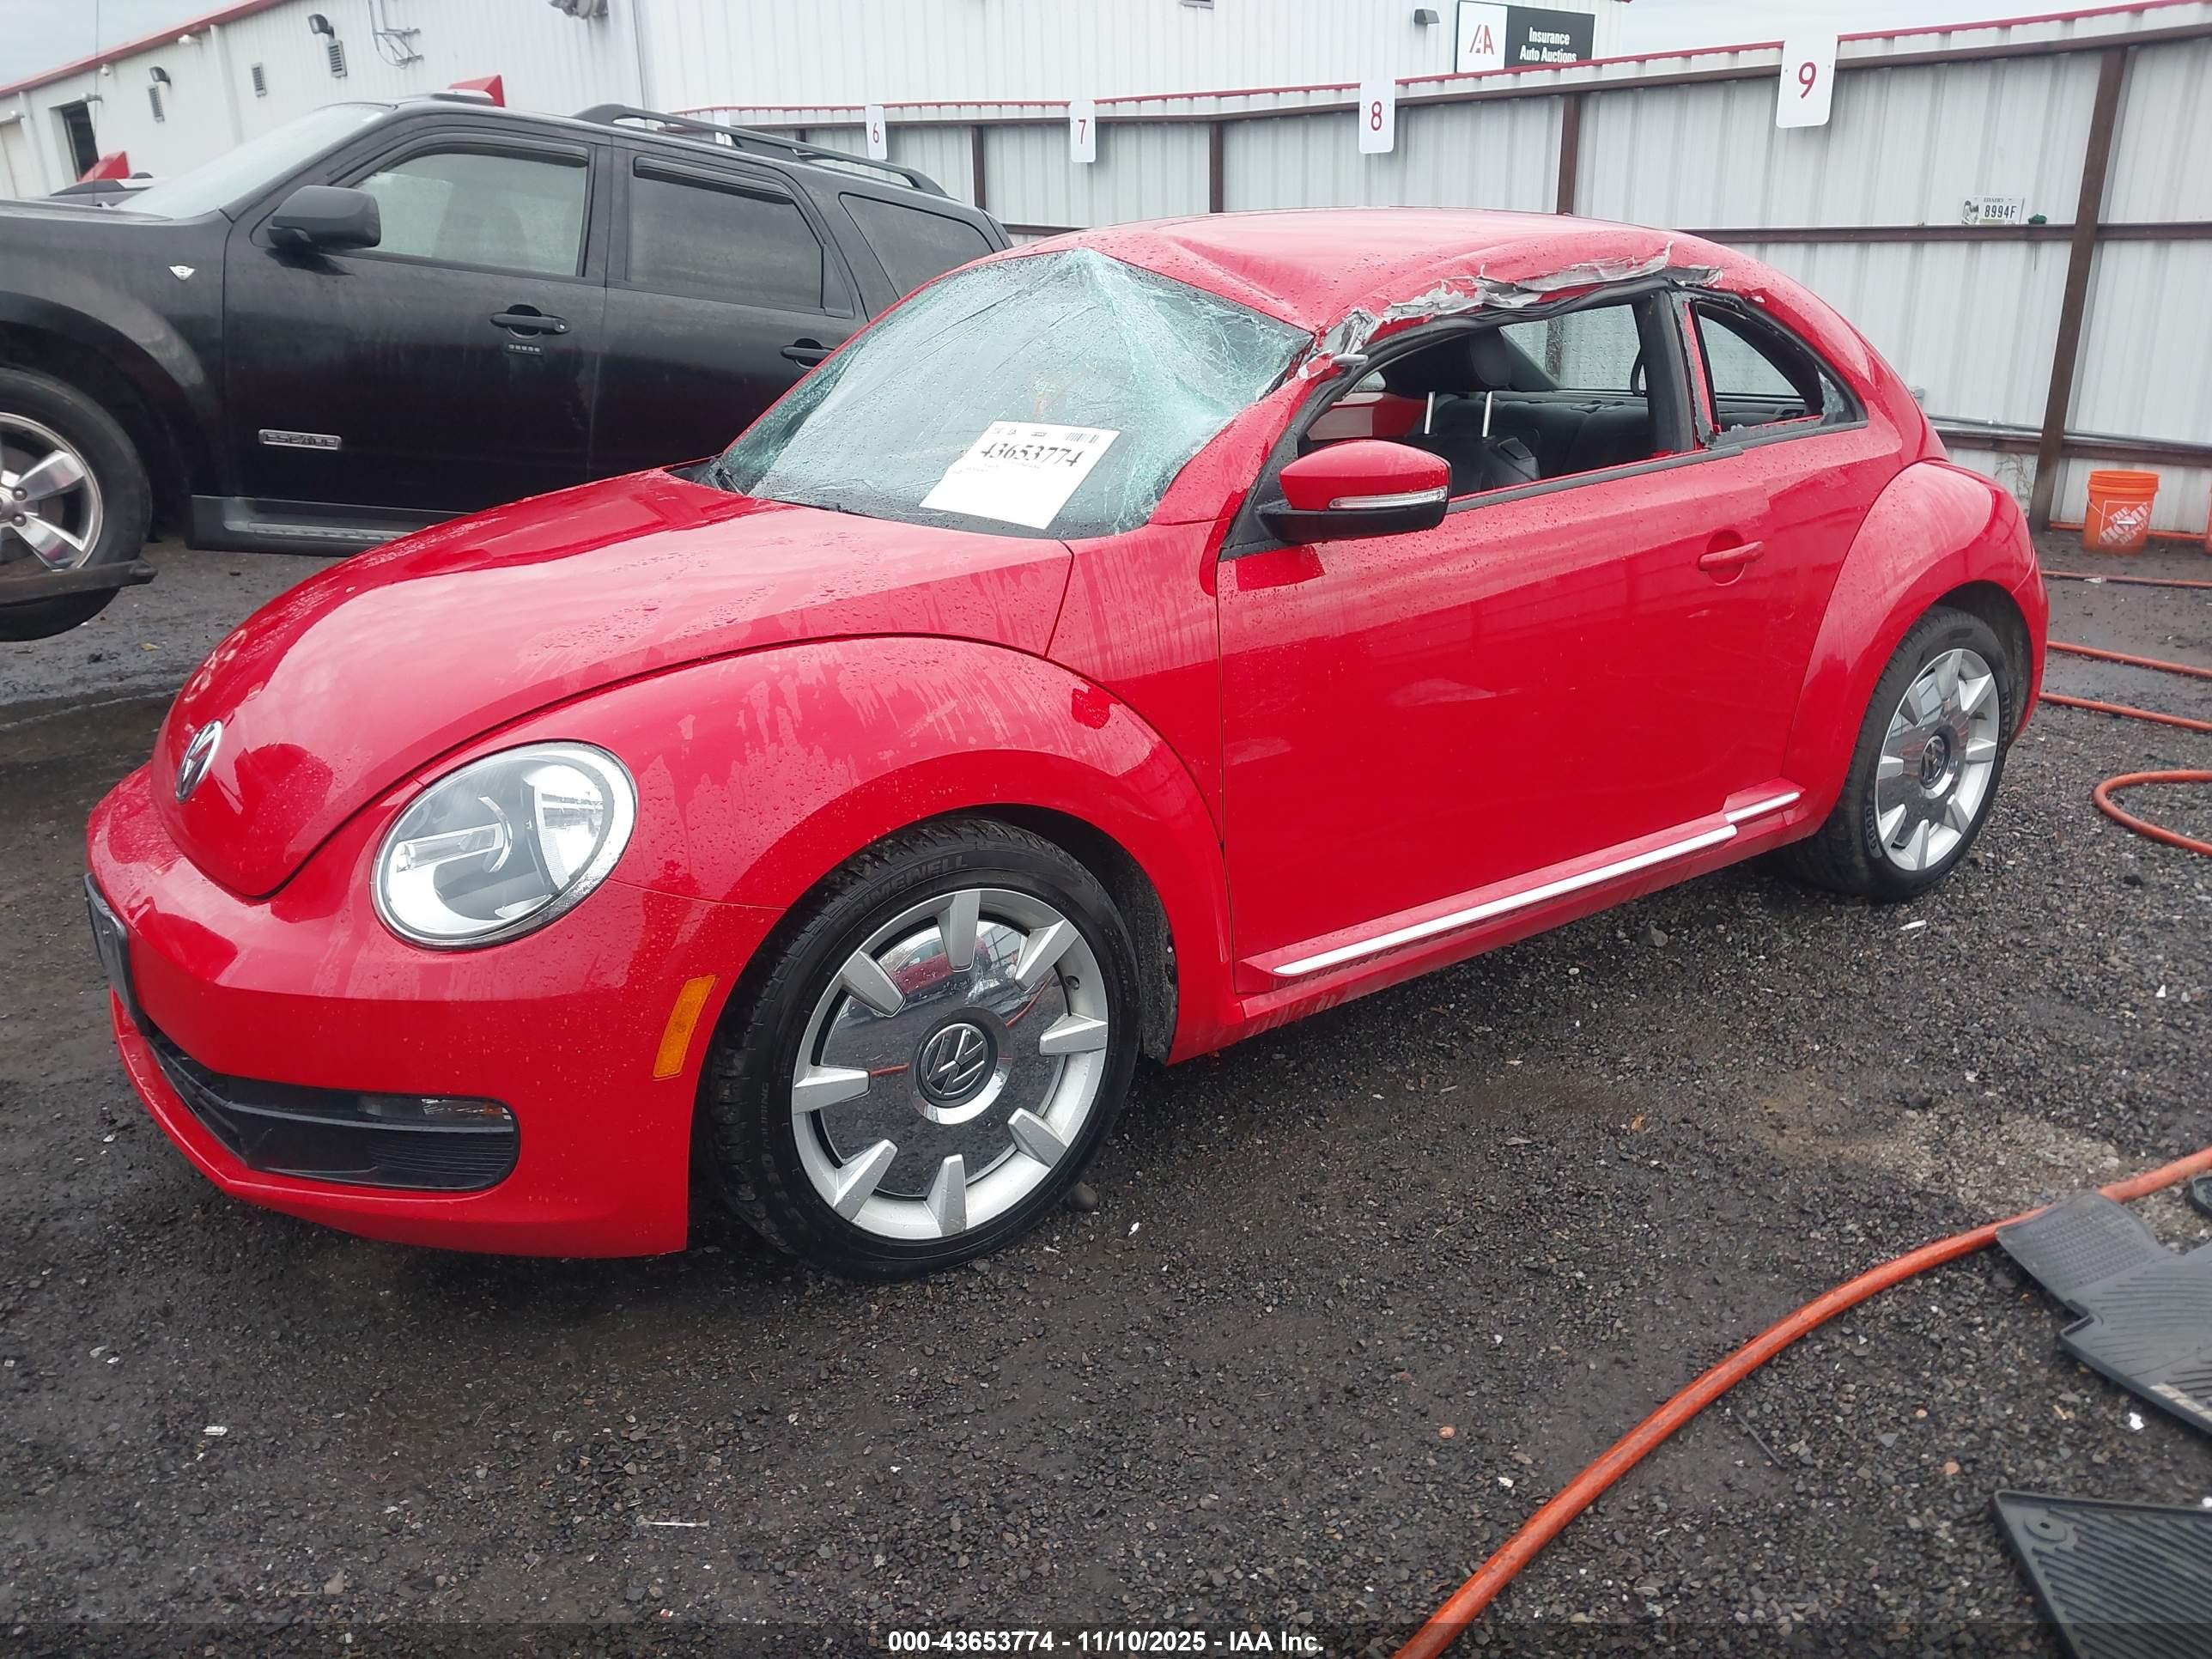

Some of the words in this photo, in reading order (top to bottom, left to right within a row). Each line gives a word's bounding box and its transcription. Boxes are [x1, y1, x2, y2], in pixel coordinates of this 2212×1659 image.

[1528, 27, 1570, 46] Insurance
[1519, 45, 1540, 61] Auto
[1540, 46, 1577, 64] Auctions
[1798, 61, 1817, 99] 9
[1370, 100, 1382, 131] 8
[872, 122, 880, 143] 6
[1078, 118, 1086, 145] 7
[1984, 204, 2017, 218] 8994F
[980, 441, 1085, 467] 43653774
[2108, 506, 2130, 524] THE
